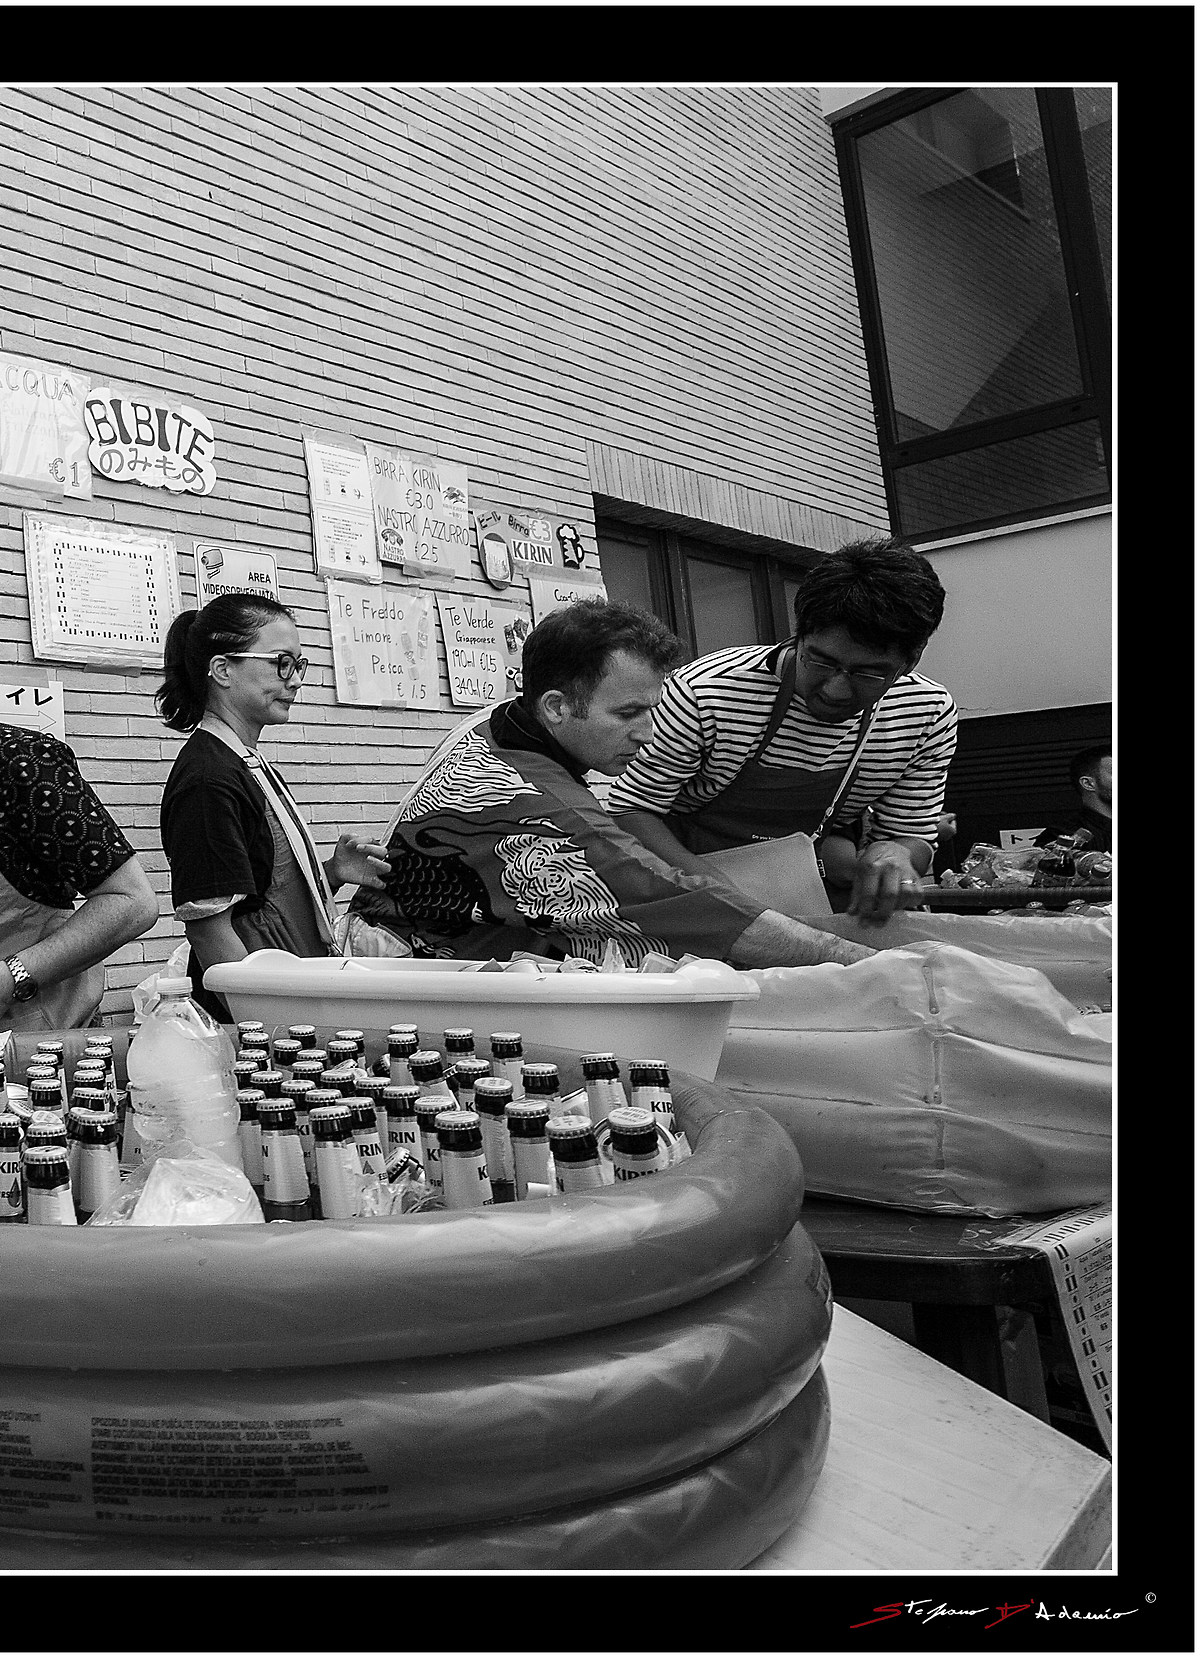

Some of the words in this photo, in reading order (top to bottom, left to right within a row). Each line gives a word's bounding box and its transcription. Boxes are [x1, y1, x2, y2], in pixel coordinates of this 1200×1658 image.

[86, 398, 214, 472] BIBITE
[99, 449, 206, 494] のみもの
[373, 456, 409, 484] BIRRA
[405, 488, 434, 511] €3.0
[422, 517, 471, 546] AZZURRO
[478, 511, 502, 530] ビール
[507, 514, 530, 536] Birra
[512, 540, 553, 565] KIRIN
[248, 571, 272, 584] AREA
[335, 594, 353, 618] Te
[361, 599, 405, 622] Freddo
[444, 606, 461, 628] Te
[463, 607, 495, 630] Verde
[371, 653, 405, 675] Pesca
